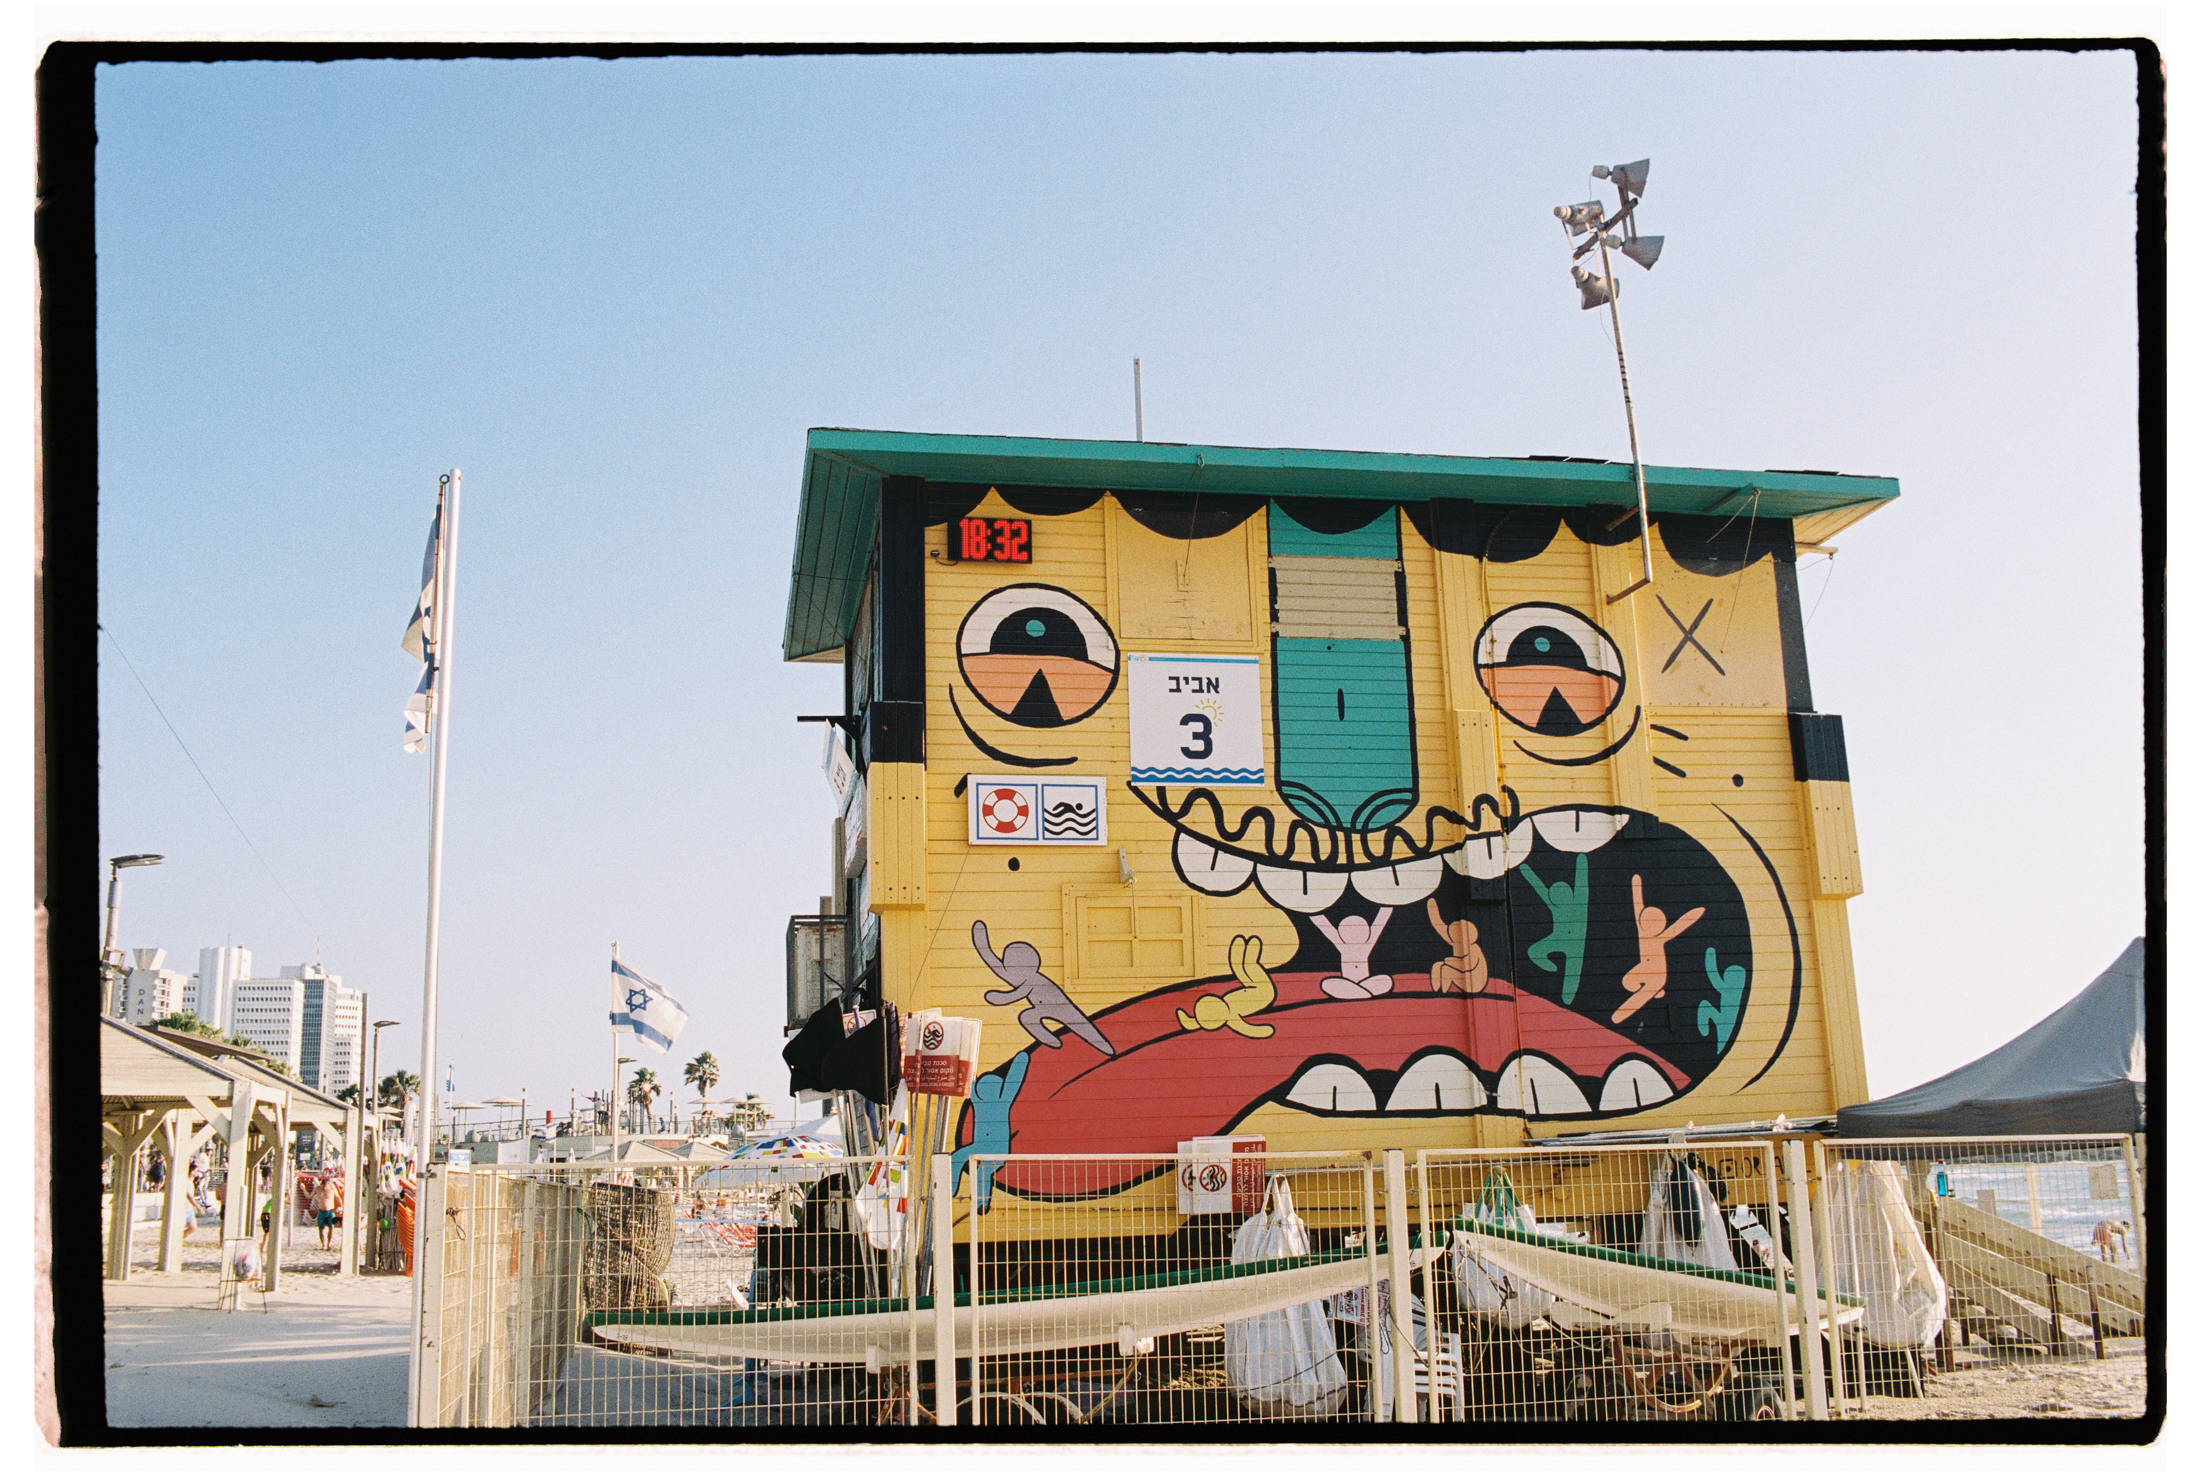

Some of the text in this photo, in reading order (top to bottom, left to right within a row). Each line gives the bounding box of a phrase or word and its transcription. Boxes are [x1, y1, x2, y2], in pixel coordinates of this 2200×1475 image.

[959, 518, 1029, 561] 18:32
[1168, 676, 1221, 695] אביב
[1179, 713, 1214, 760] 3
[137, 988, 145, 1015] DAN
